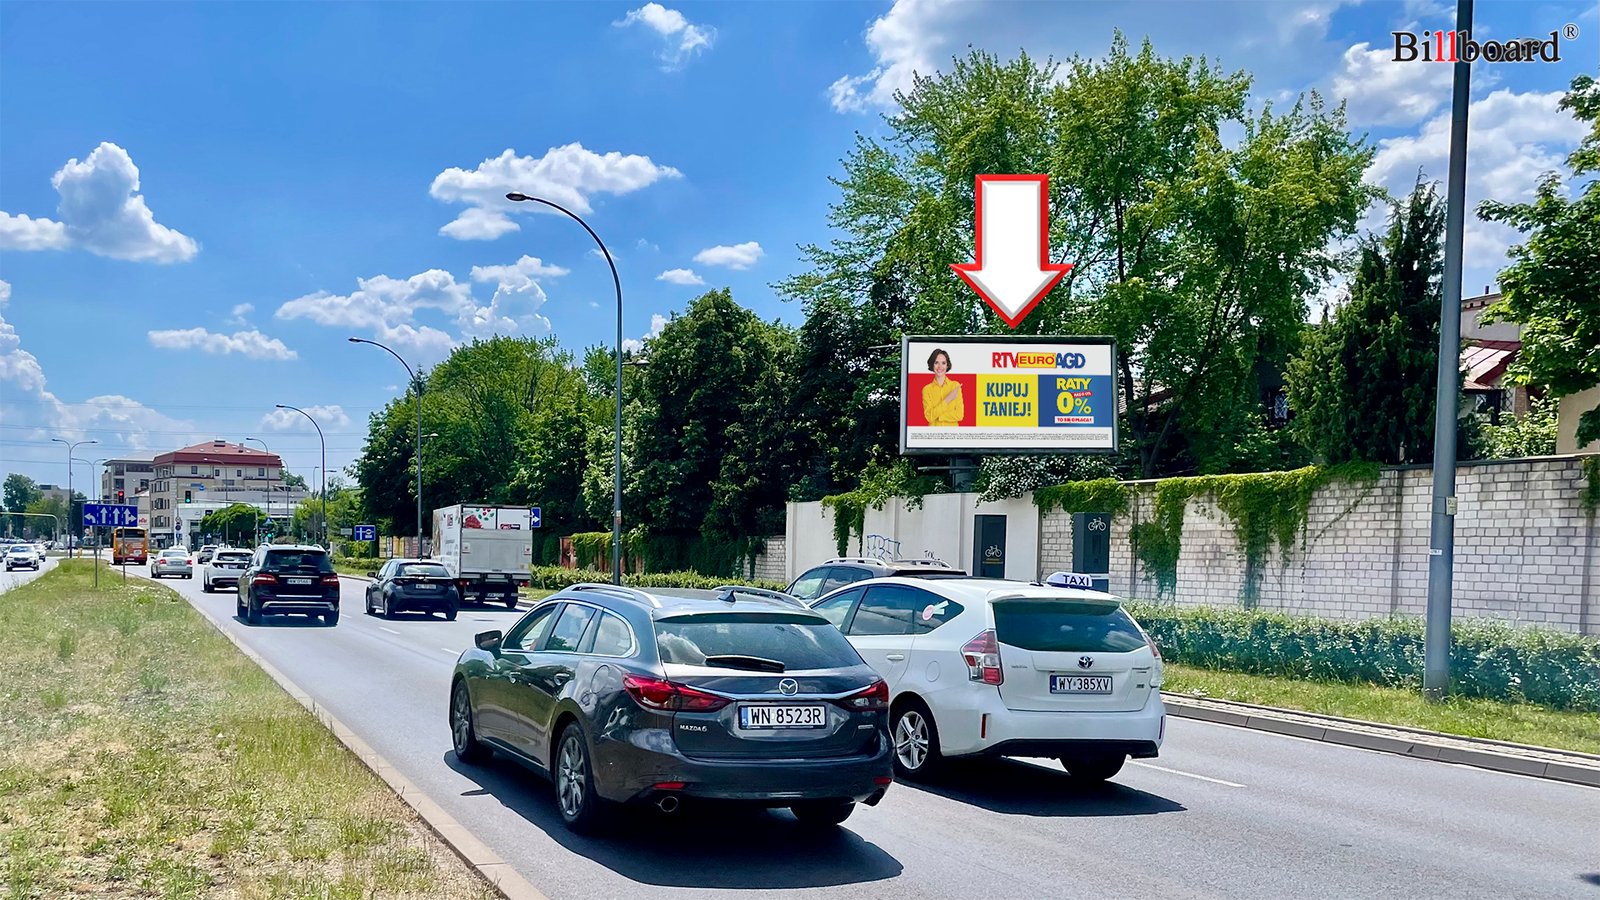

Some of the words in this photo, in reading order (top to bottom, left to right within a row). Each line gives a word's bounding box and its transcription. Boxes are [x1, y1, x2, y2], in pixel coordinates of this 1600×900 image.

[992, 352, 1018, 368] RTV
[1019, 355, 1055, 365] EURO
[1056, 352, 1086, 369] AGD
[986, 383, 1029, 398] KUPUJ
[1056, 378, 1092, 391] RATY
[983, 402, 1031, 417] TANIEJ!
[1056, 392, 1092, 415] 0%
[1062, 574, 1089, 586] TAXI
[1058, 678, 1073, 690] WY
[1076, 678, 1110, 691] 385XV
[751, 708, 771, 724] WN
[776, 708, 822, 724] 8523R
